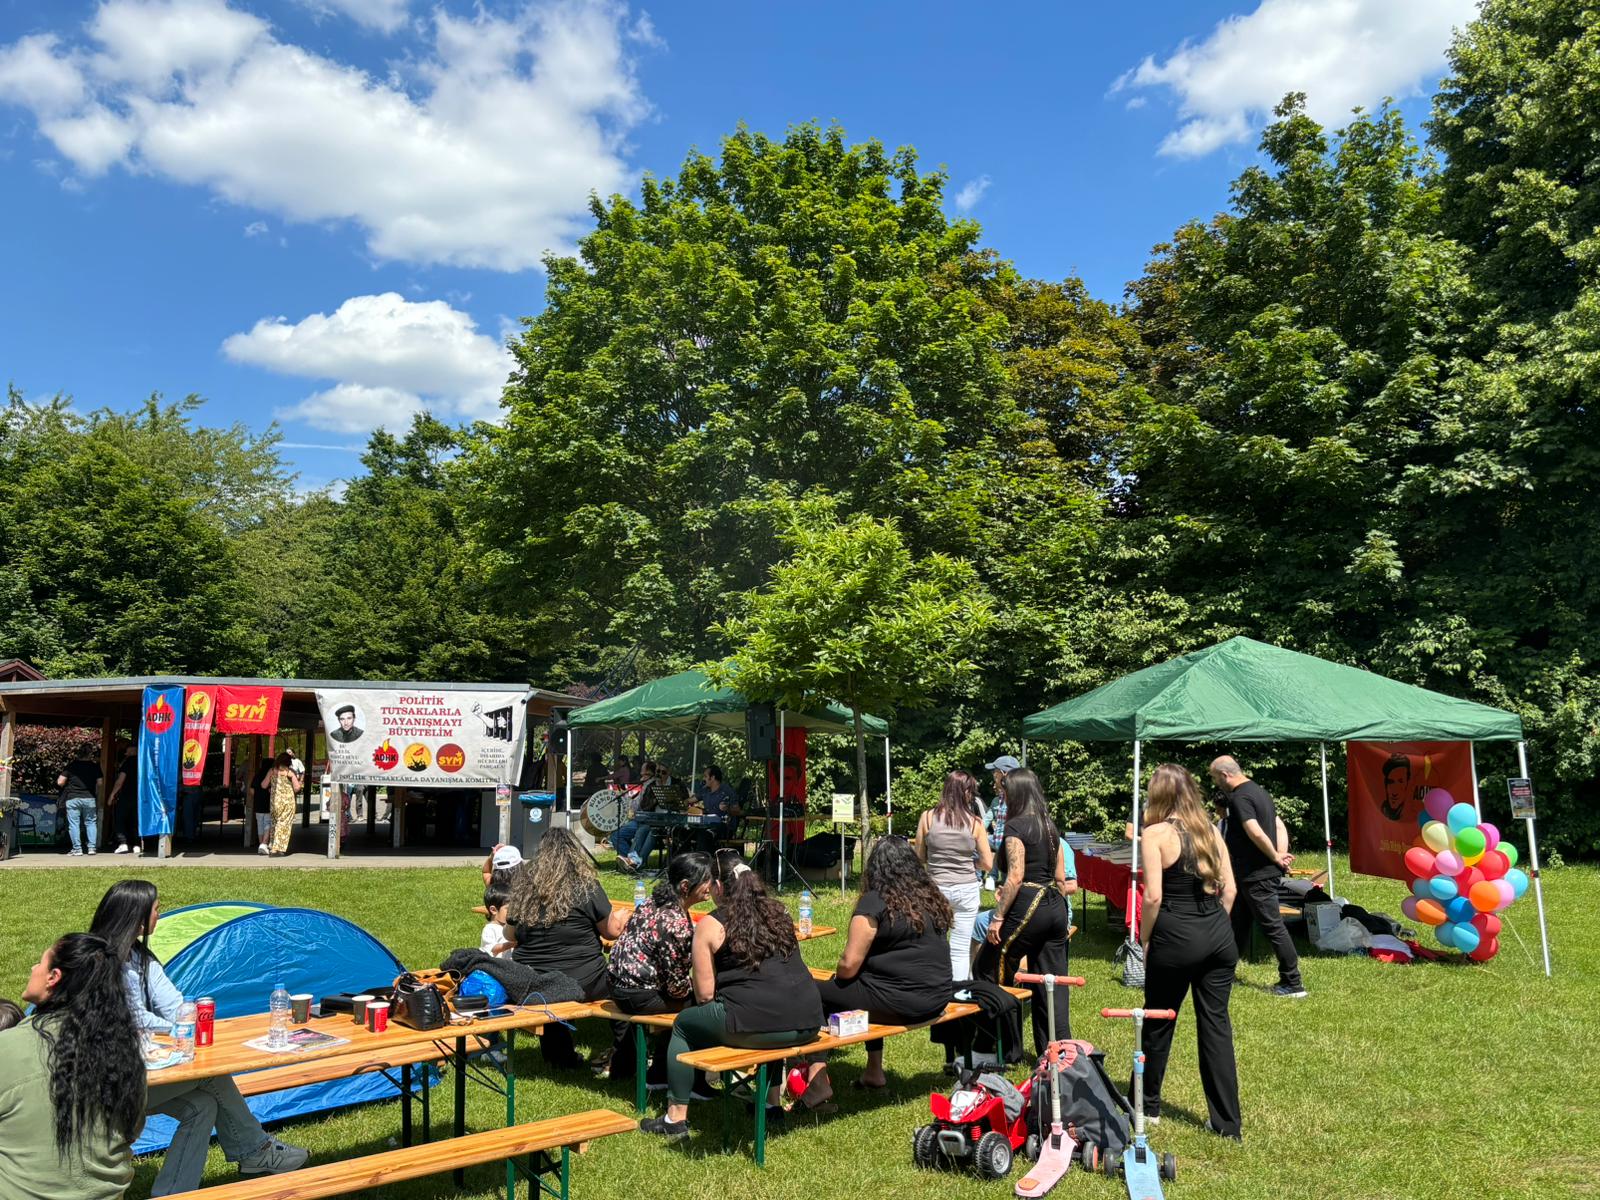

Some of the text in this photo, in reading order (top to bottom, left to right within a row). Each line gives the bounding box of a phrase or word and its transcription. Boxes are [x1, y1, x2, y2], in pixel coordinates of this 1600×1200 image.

[399, 695, 445, 705] POLİTİK
[225, 703, 267, 719] SYM
[380, 707, 462, 716] TUTSAKLARLA
[147, 712, 171, 722] ADHK
[382, 717, 462, 728] DAYANIŞMAYI
[388, 727, 453, 737] BÜYÜTELİM
[375, 753, 396, 763] ADHK
[438, 756, 463, 766] SYM
[420, 776, 463, 784] DAYANIŞMA
